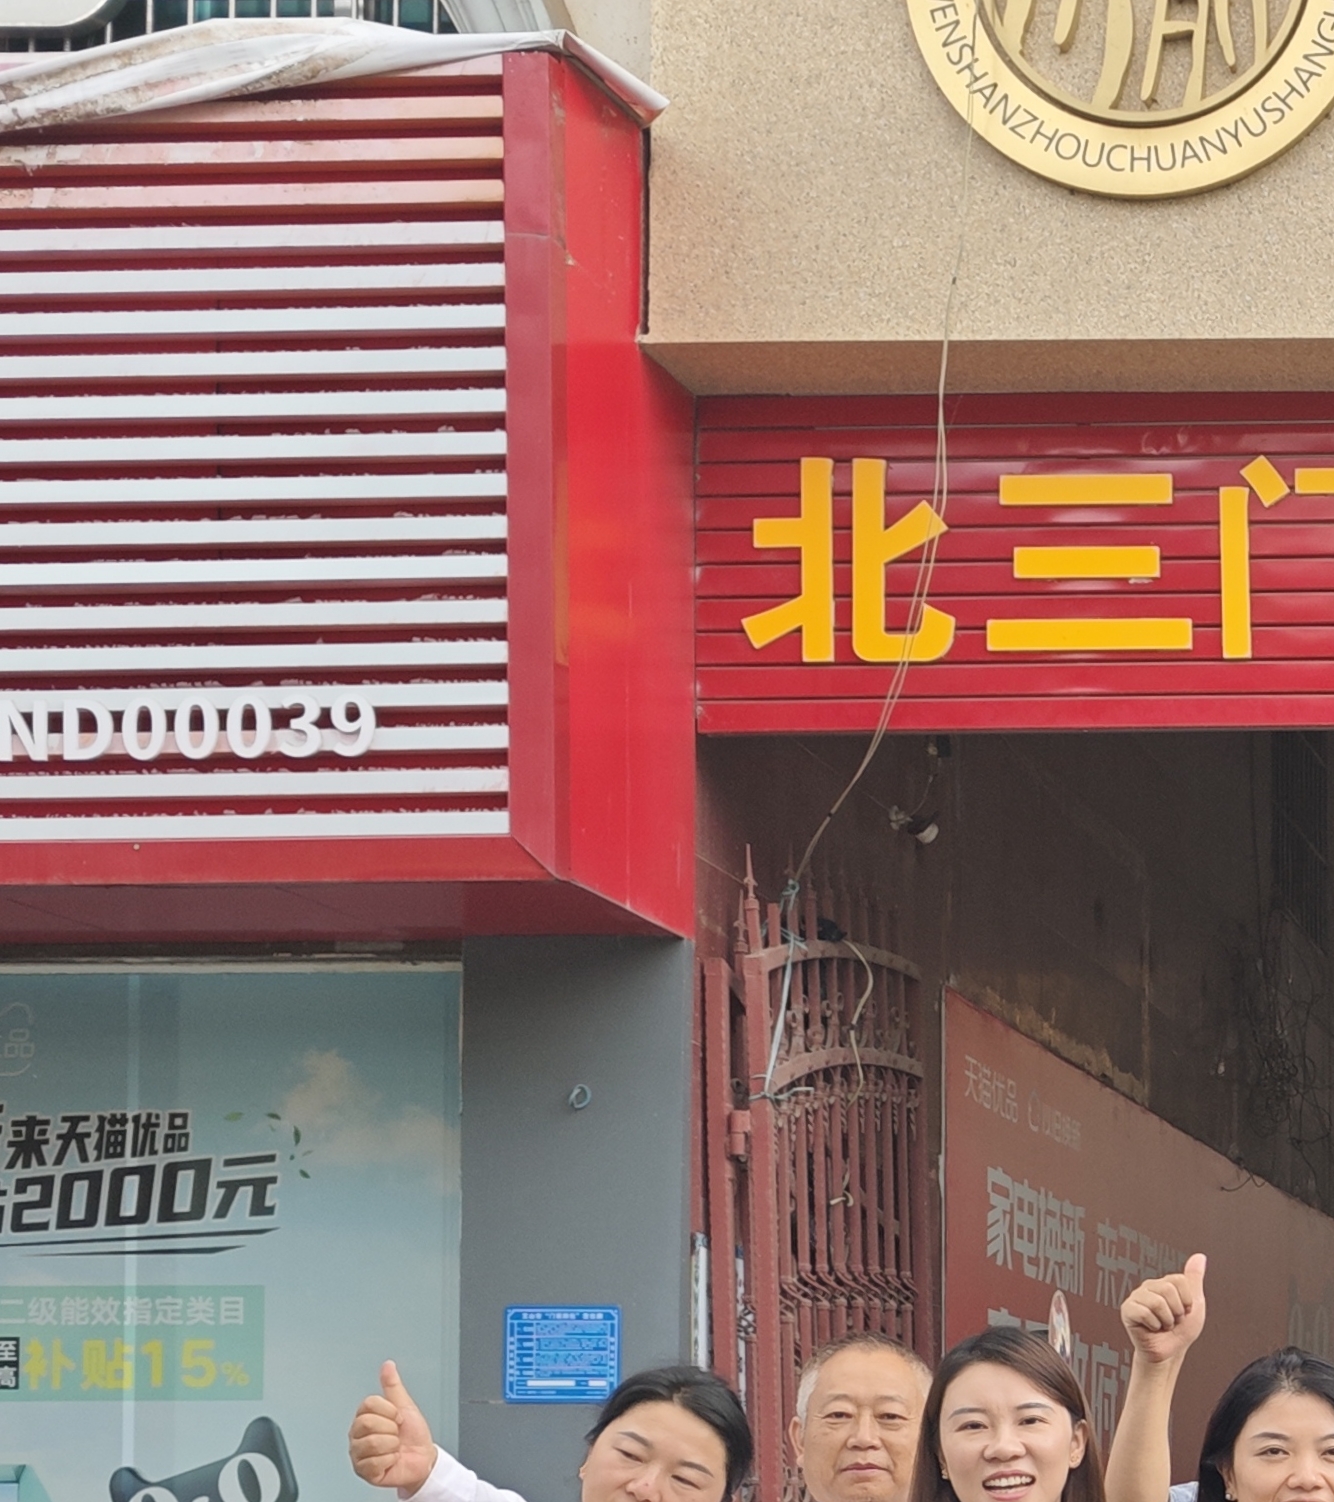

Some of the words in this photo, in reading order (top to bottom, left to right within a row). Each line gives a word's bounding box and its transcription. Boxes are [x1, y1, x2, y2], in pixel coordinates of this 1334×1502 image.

[0, 693, 377, 762] ND00039
[0, 1110, 190, 1170] 来天猫优品
[0, 1153, 278, 1234] 2000元
[987, 1165, 1085, 1297] 家电换新
[22, 1338, 250, 1391] 补贴15%
